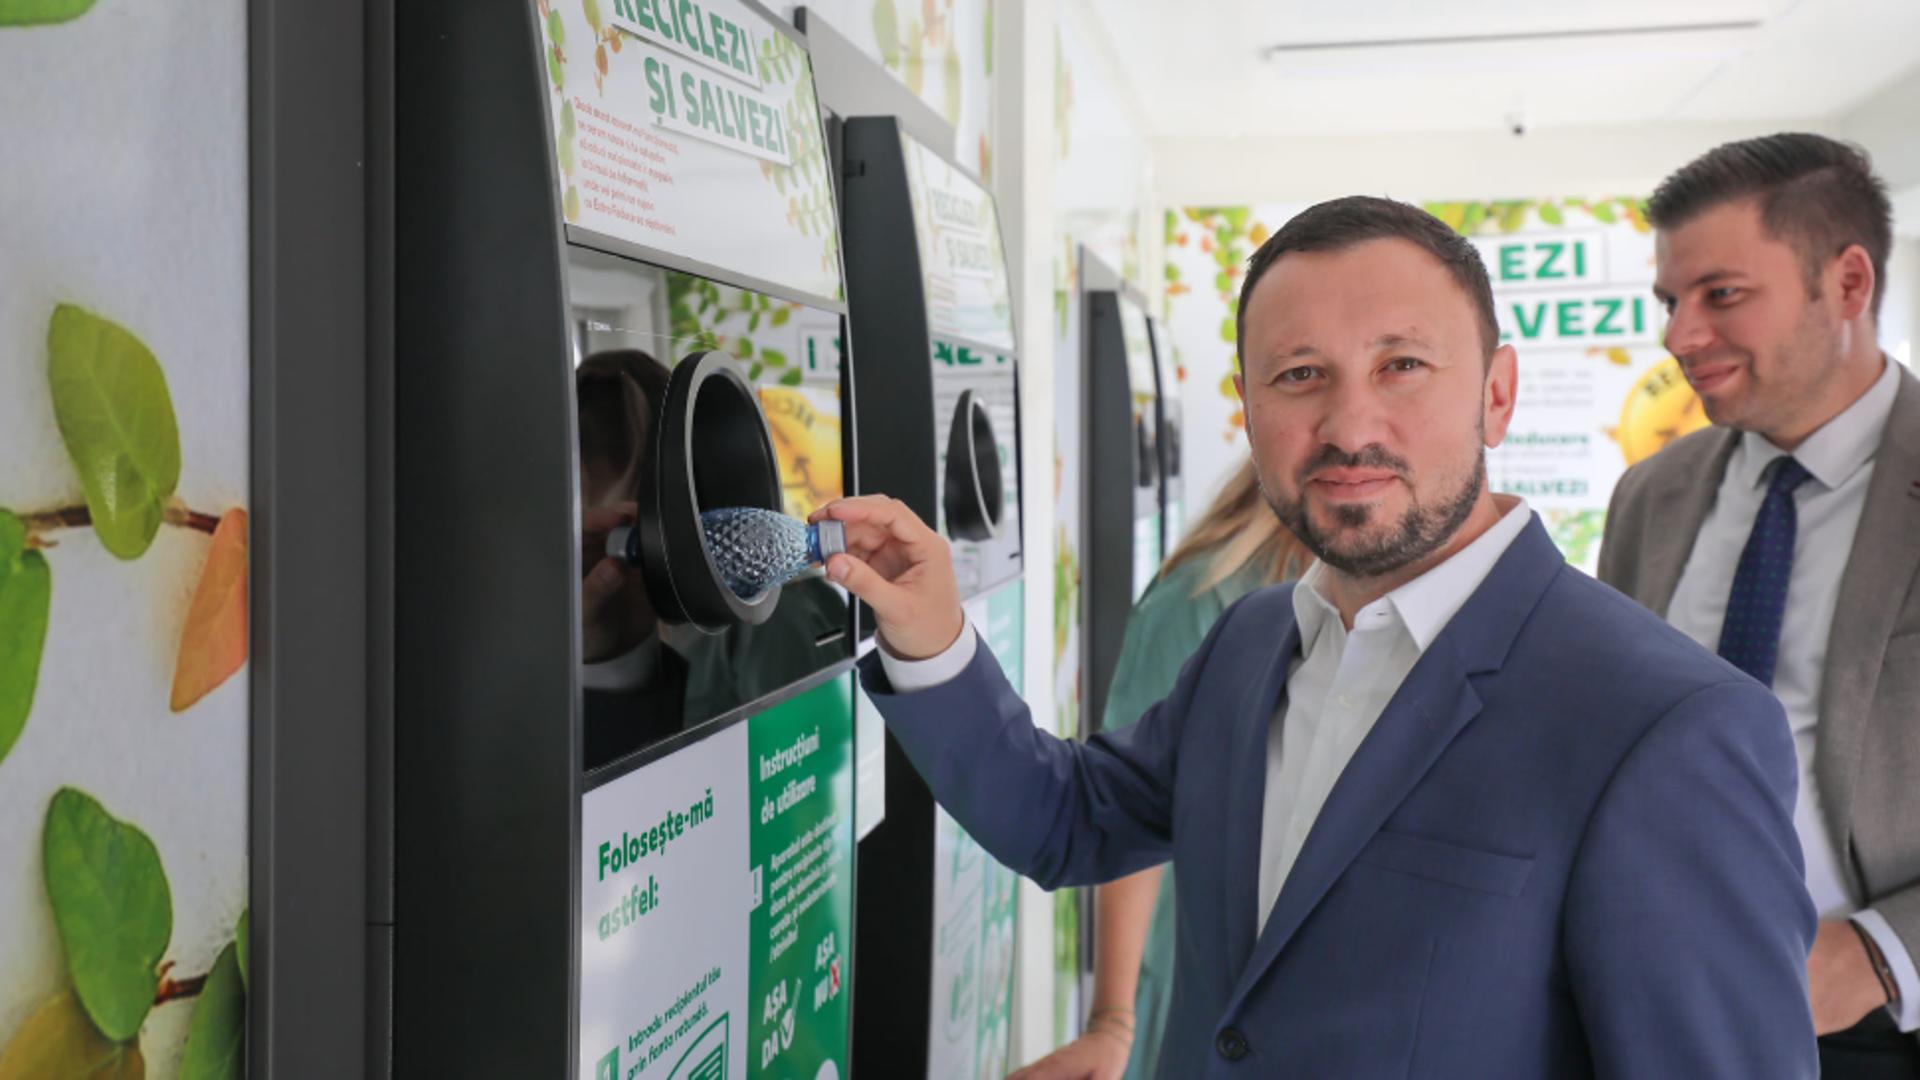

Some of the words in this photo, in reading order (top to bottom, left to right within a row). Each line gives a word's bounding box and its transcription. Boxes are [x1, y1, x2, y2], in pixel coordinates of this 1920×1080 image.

[644, 56, 677, 124] ȘI
[680, 71, 786, 155] SALVEZI
[760, 725, 819, 782] Instrucțiuni
[761, 795, 775, 825] de
[777, 774, 816, 815] utilizare
[598, 787, 715, 882] Folosește-mă
[598, 875, 660, 942] astfel:
[815, 931, 836, 973] AȘA
[664, 972, 708, 1023] recipientul
[762, 978, 789, 1026] AȘA
[814, 974, 830, 1013] NU
[761, 1029, 779, 1071] DA
